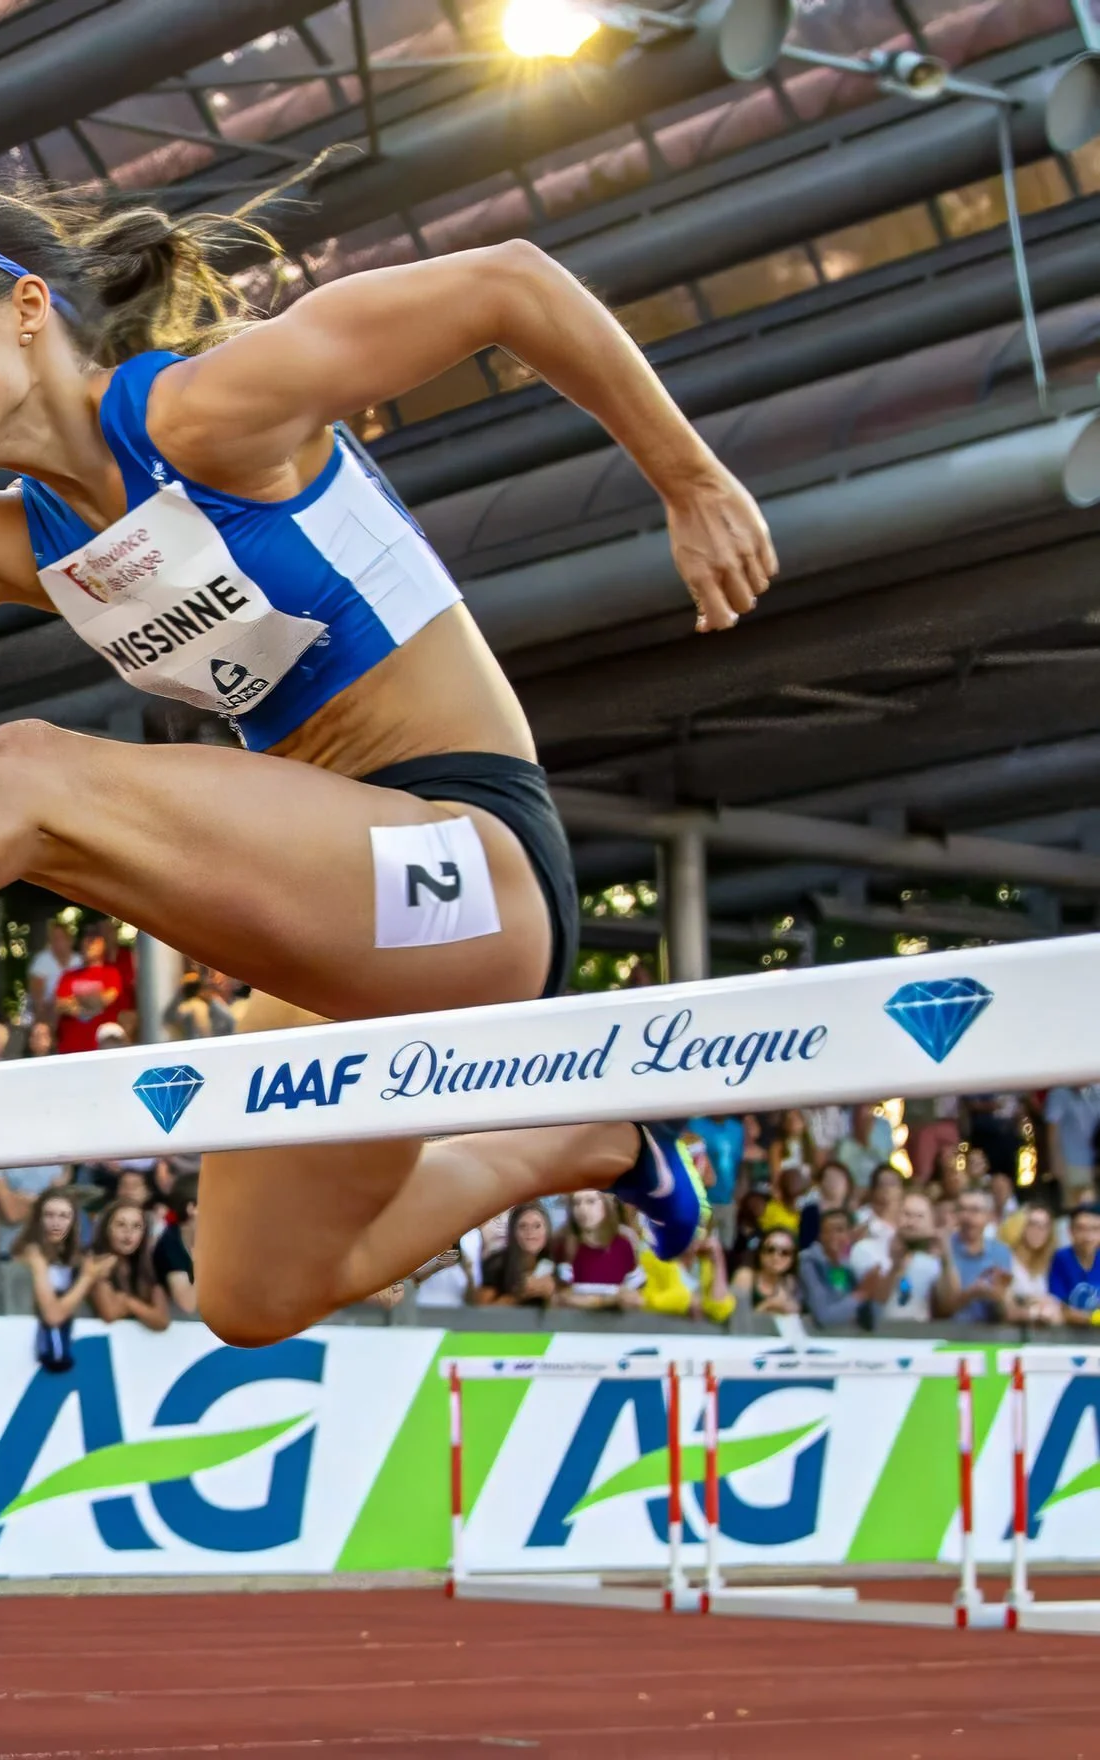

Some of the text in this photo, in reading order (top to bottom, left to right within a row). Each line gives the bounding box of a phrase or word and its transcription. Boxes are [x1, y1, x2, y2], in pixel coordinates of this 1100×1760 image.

[103, 575, 251, 673] MISSINNE
[405, 861, 461, 907] 2
[245, 1009, 828, 1114] IAAF Diamond League
[524, 1346, 836, 1546] AG
